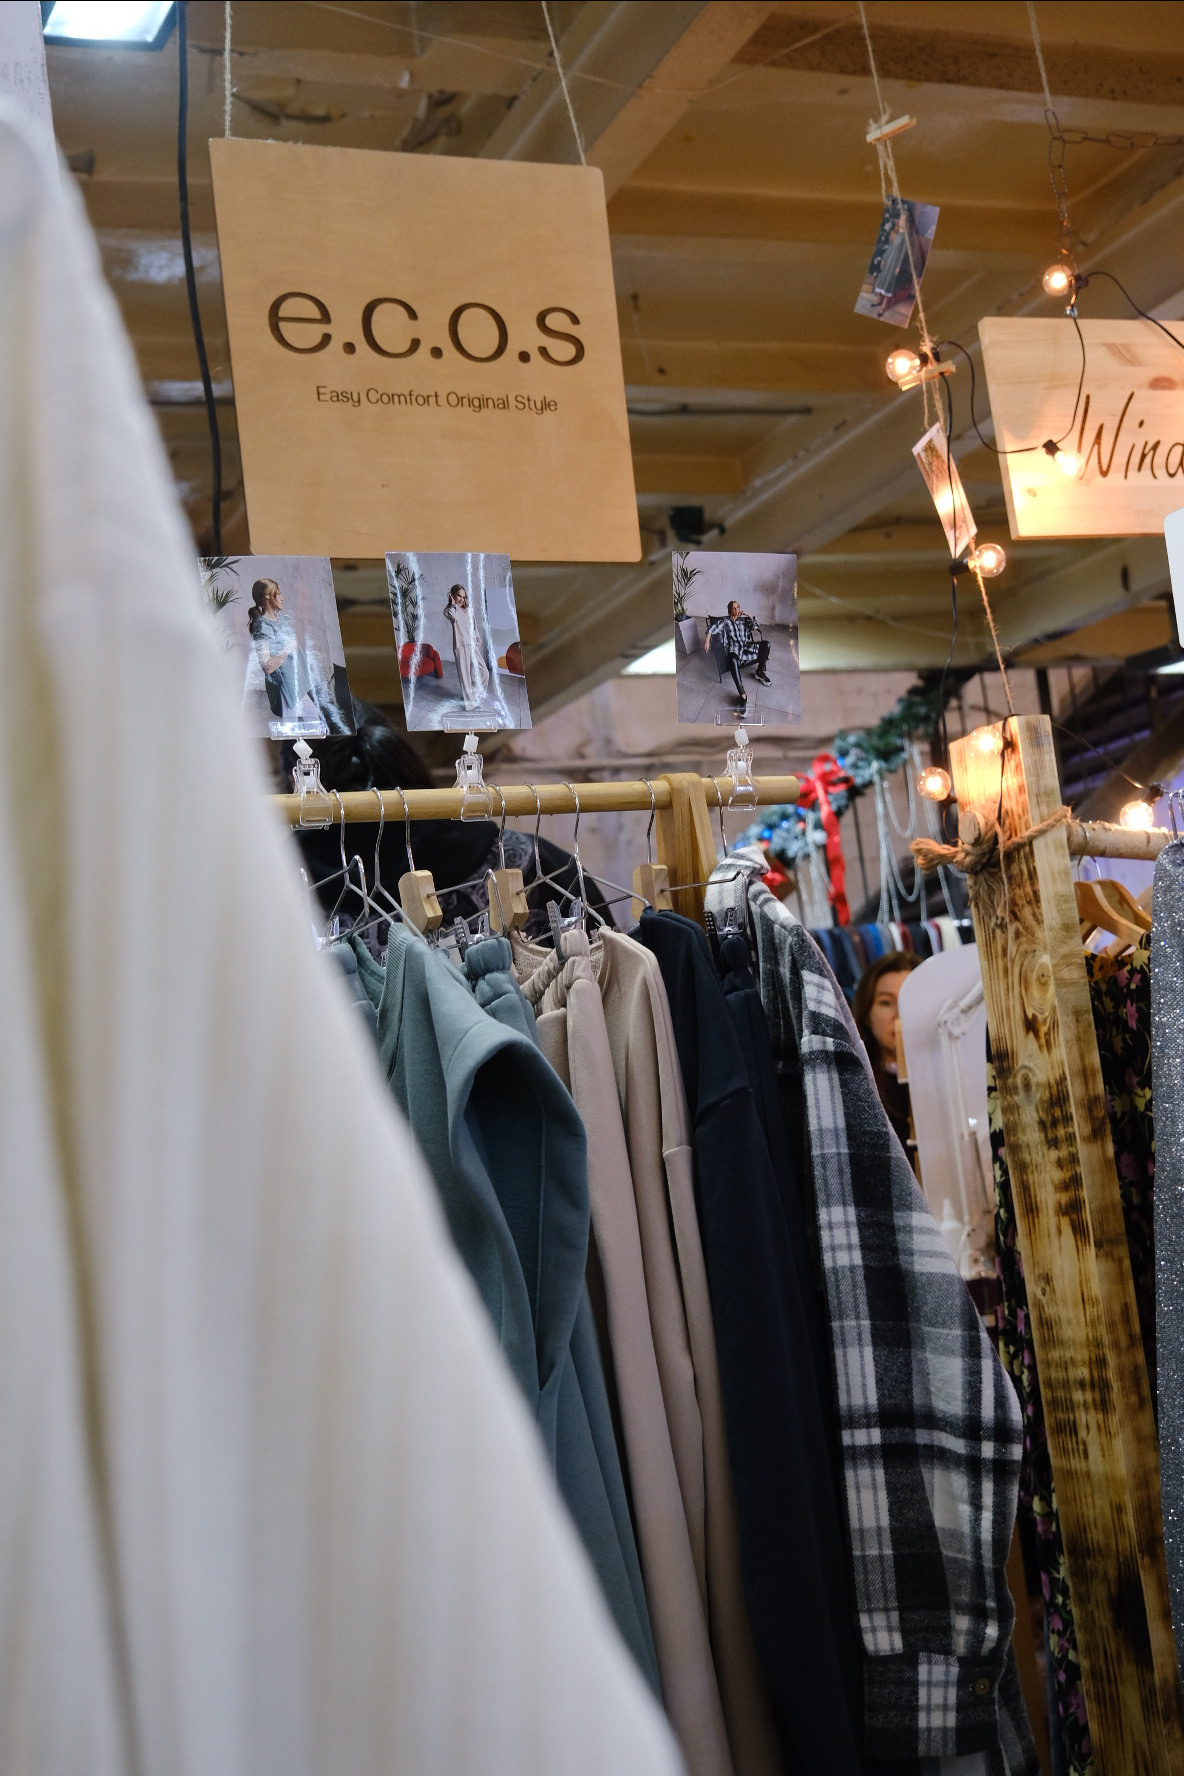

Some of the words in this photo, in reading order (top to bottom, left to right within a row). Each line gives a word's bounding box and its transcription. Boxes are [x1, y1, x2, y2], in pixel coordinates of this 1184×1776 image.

[267, 291, 586, 367] e.c.o.s
[316, 385, 361, 408] Easy
[366, 387, 441, 408] Comfort
[446, 391, 509, 413] Original
[514, 394, 558, 415] Style
